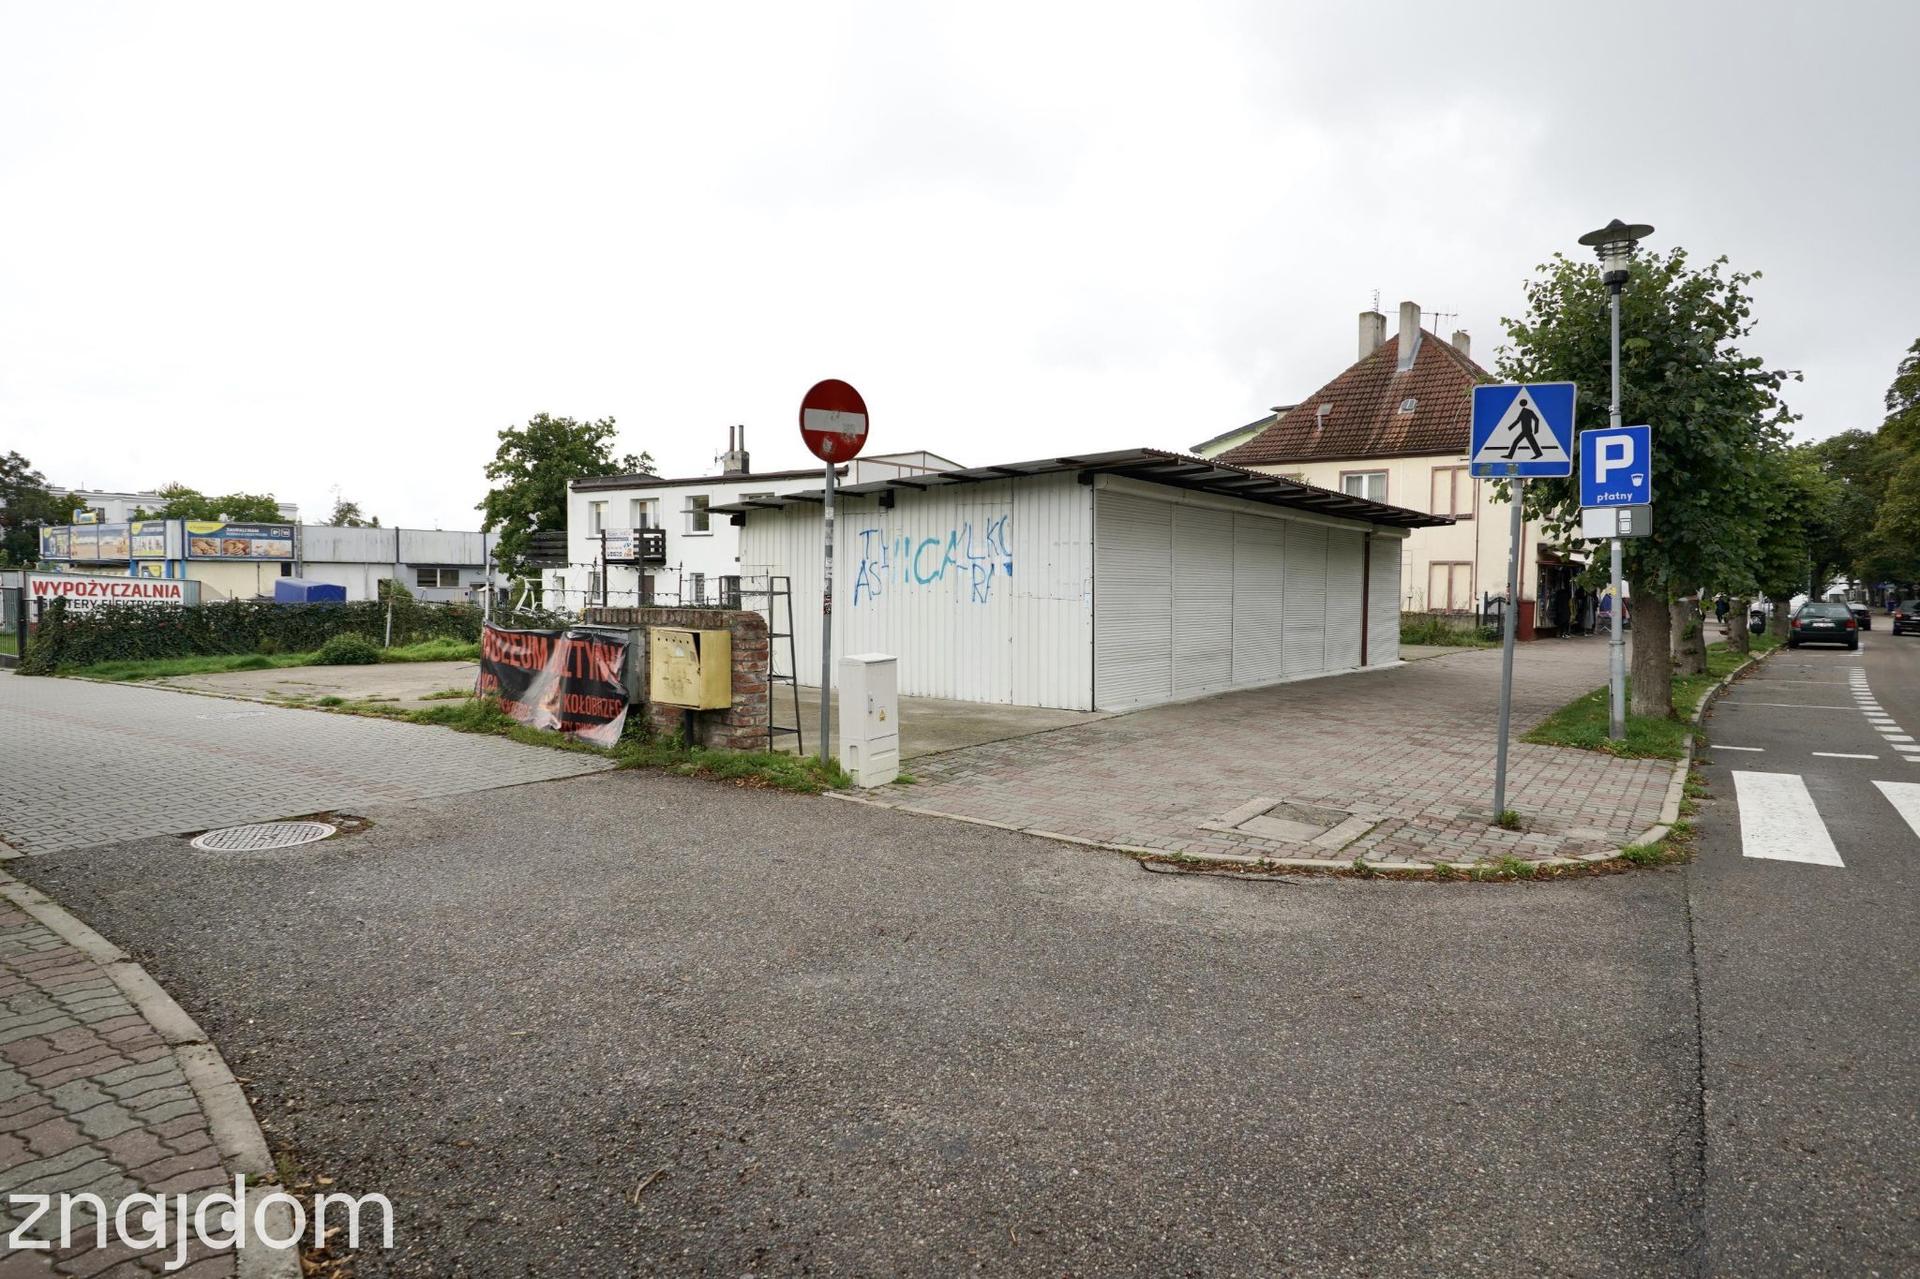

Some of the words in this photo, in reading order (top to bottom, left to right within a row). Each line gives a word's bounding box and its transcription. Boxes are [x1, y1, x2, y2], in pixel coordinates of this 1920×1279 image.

[1595, 434, 1634, 483] P
[1597, 491, 1633, 503] płatny
[32, 579, 181, 599] WYPOŻYCZALNIA
